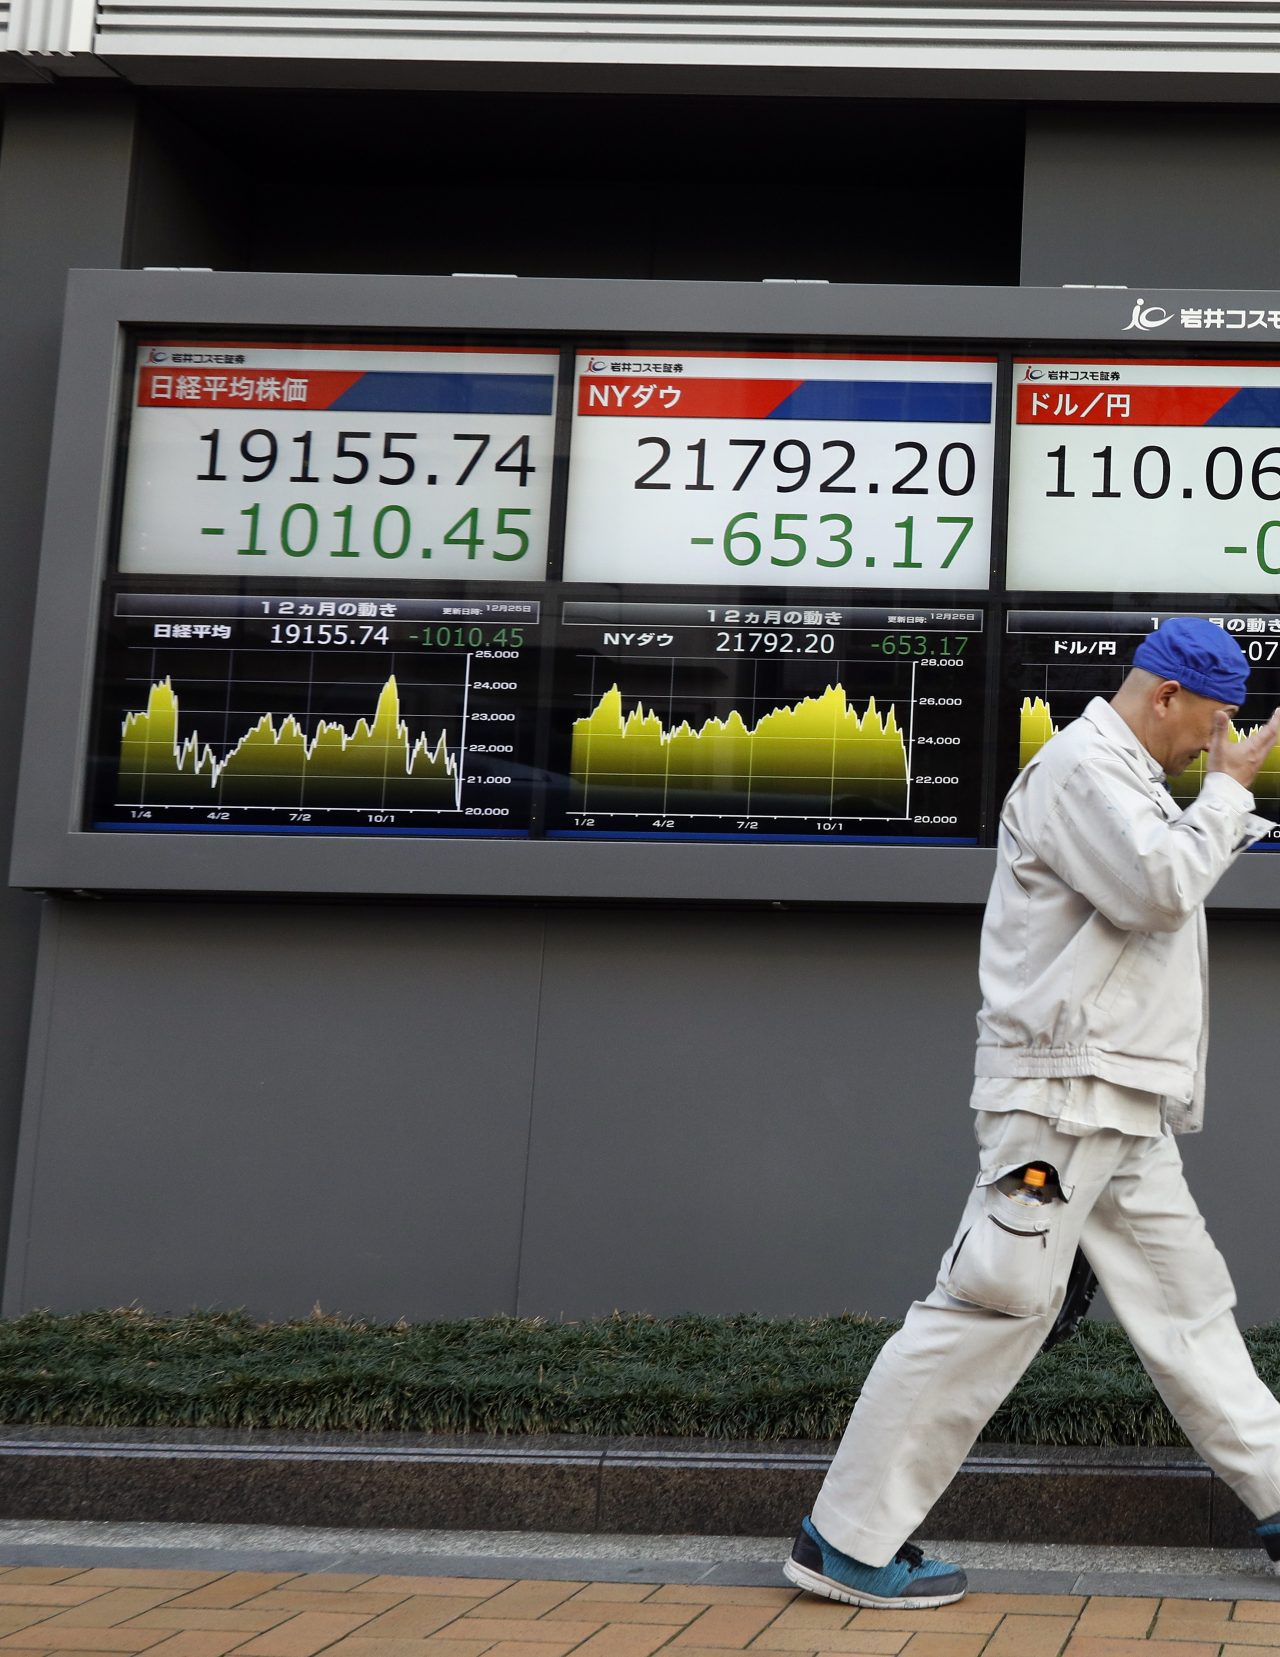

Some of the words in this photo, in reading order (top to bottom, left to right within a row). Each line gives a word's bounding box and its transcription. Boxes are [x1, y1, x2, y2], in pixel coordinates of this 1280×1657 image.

[172, 353, 245, 364] 岩井コスモ証券
[610, 362, 683, 373] 岩井コスモ証券
[1048, 370, 1120, 381] 岩井コスモ証券
[150, 376, 308, 401] 日経平均株価
[589, 384, 682, 409] NYダウ
[197, 429, 536, 486] 19155.74
[634, 436, 976, 495] 21792.20
[201, 503, 531, 561] -1010.45
[691, 511, 973, 568] -653.17
[154, 624, 231, 639] 日経平均
[271, 624, 388, 644] 19155.74
[409, 627, 523, 647] -1010.45
[604, 632, 673, 647] NYダウ
[716, 632, 834, 653] 21792.20
[871, 636, 968, 656] -653.17
[1054, 640, 1116, 655] ドル/円
[475, 650, 518, 659] 25,000
[921, 659, 963, 667] 28,000
[474, 681, 516, 690] 24,000
[919, 698, 962, 706] 26,000
[472, 713, 515, 721] 23,000
[917, 737, 960, 745] 24,000
[470, 744, 513, 753] 22,000
[468, 776, 510, 784] 21,000
[916, 776, 958, 784] 22,000
[131, 810, 151, 819] 1/4
[207, 812, 229, 820] 4/2
[289, 813, 311, 822] 7/2
[368, 814, 395, 823] 10/1
[466, 807, 509, 816] 20,000
[574, 819, 595, 827] 1/2
[653, 820, 674, 828] 4/2
[737, 822, 758, 830] 7/2
[817, 823, 843, 831] 10/1
[914, 815, 957, 824] 20,000
